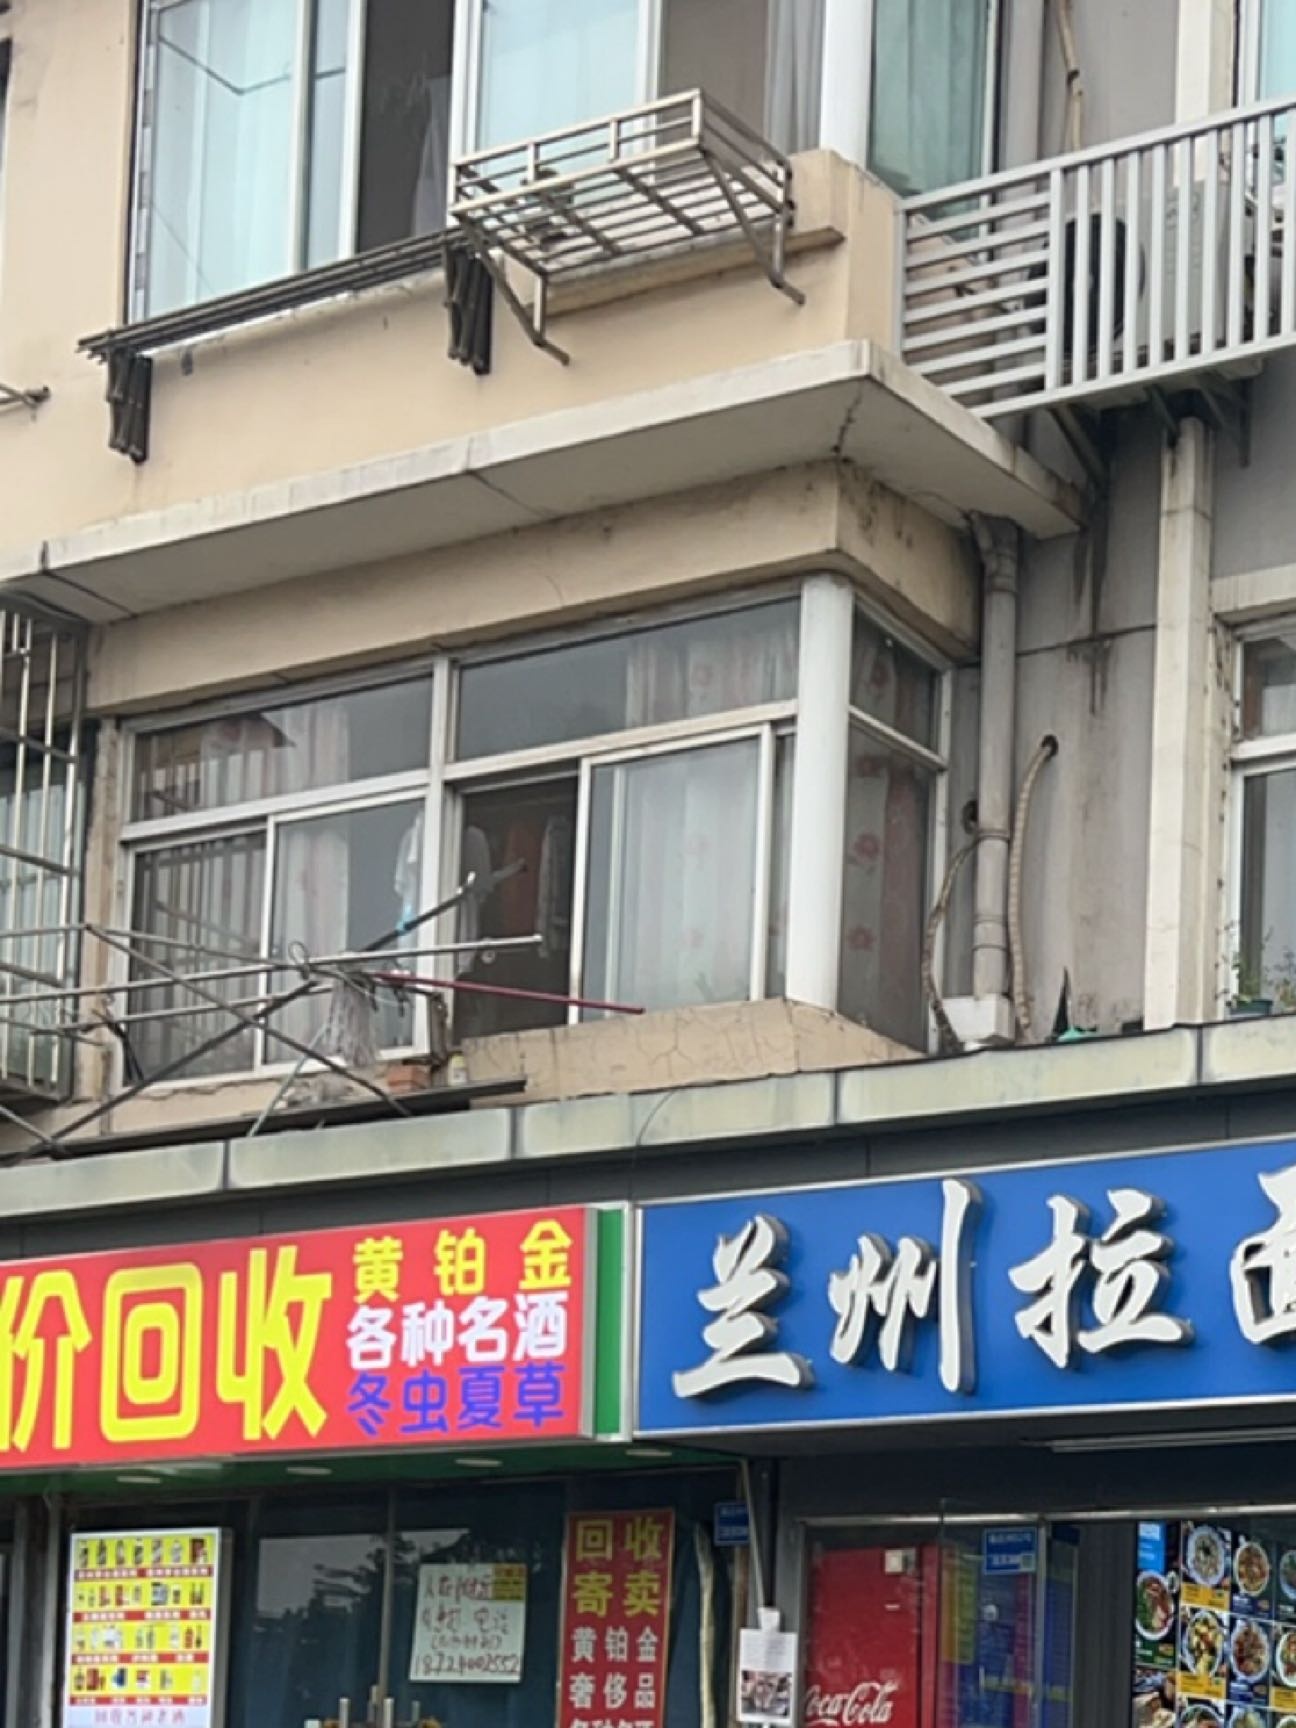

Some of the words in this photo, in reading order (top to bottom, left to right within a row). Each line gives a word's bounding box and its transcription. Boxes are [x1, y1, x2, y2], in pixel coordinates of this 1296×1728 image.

[352, 1219, 573, 1303] 黄铂金
[0, 1245, 333, 1453] 价回收
[346, 1292, 568, 1371] 各种名酒
[346, 1360, 566, 1437] 冬虫夏草
[576, 1517, 664, 1562] 回收
[573, 1569, 660, 1618] 寄卖
[571, 1626, 659, 1663] 黄铂金
[569, 1671, 656, 1709] 奢侈品
